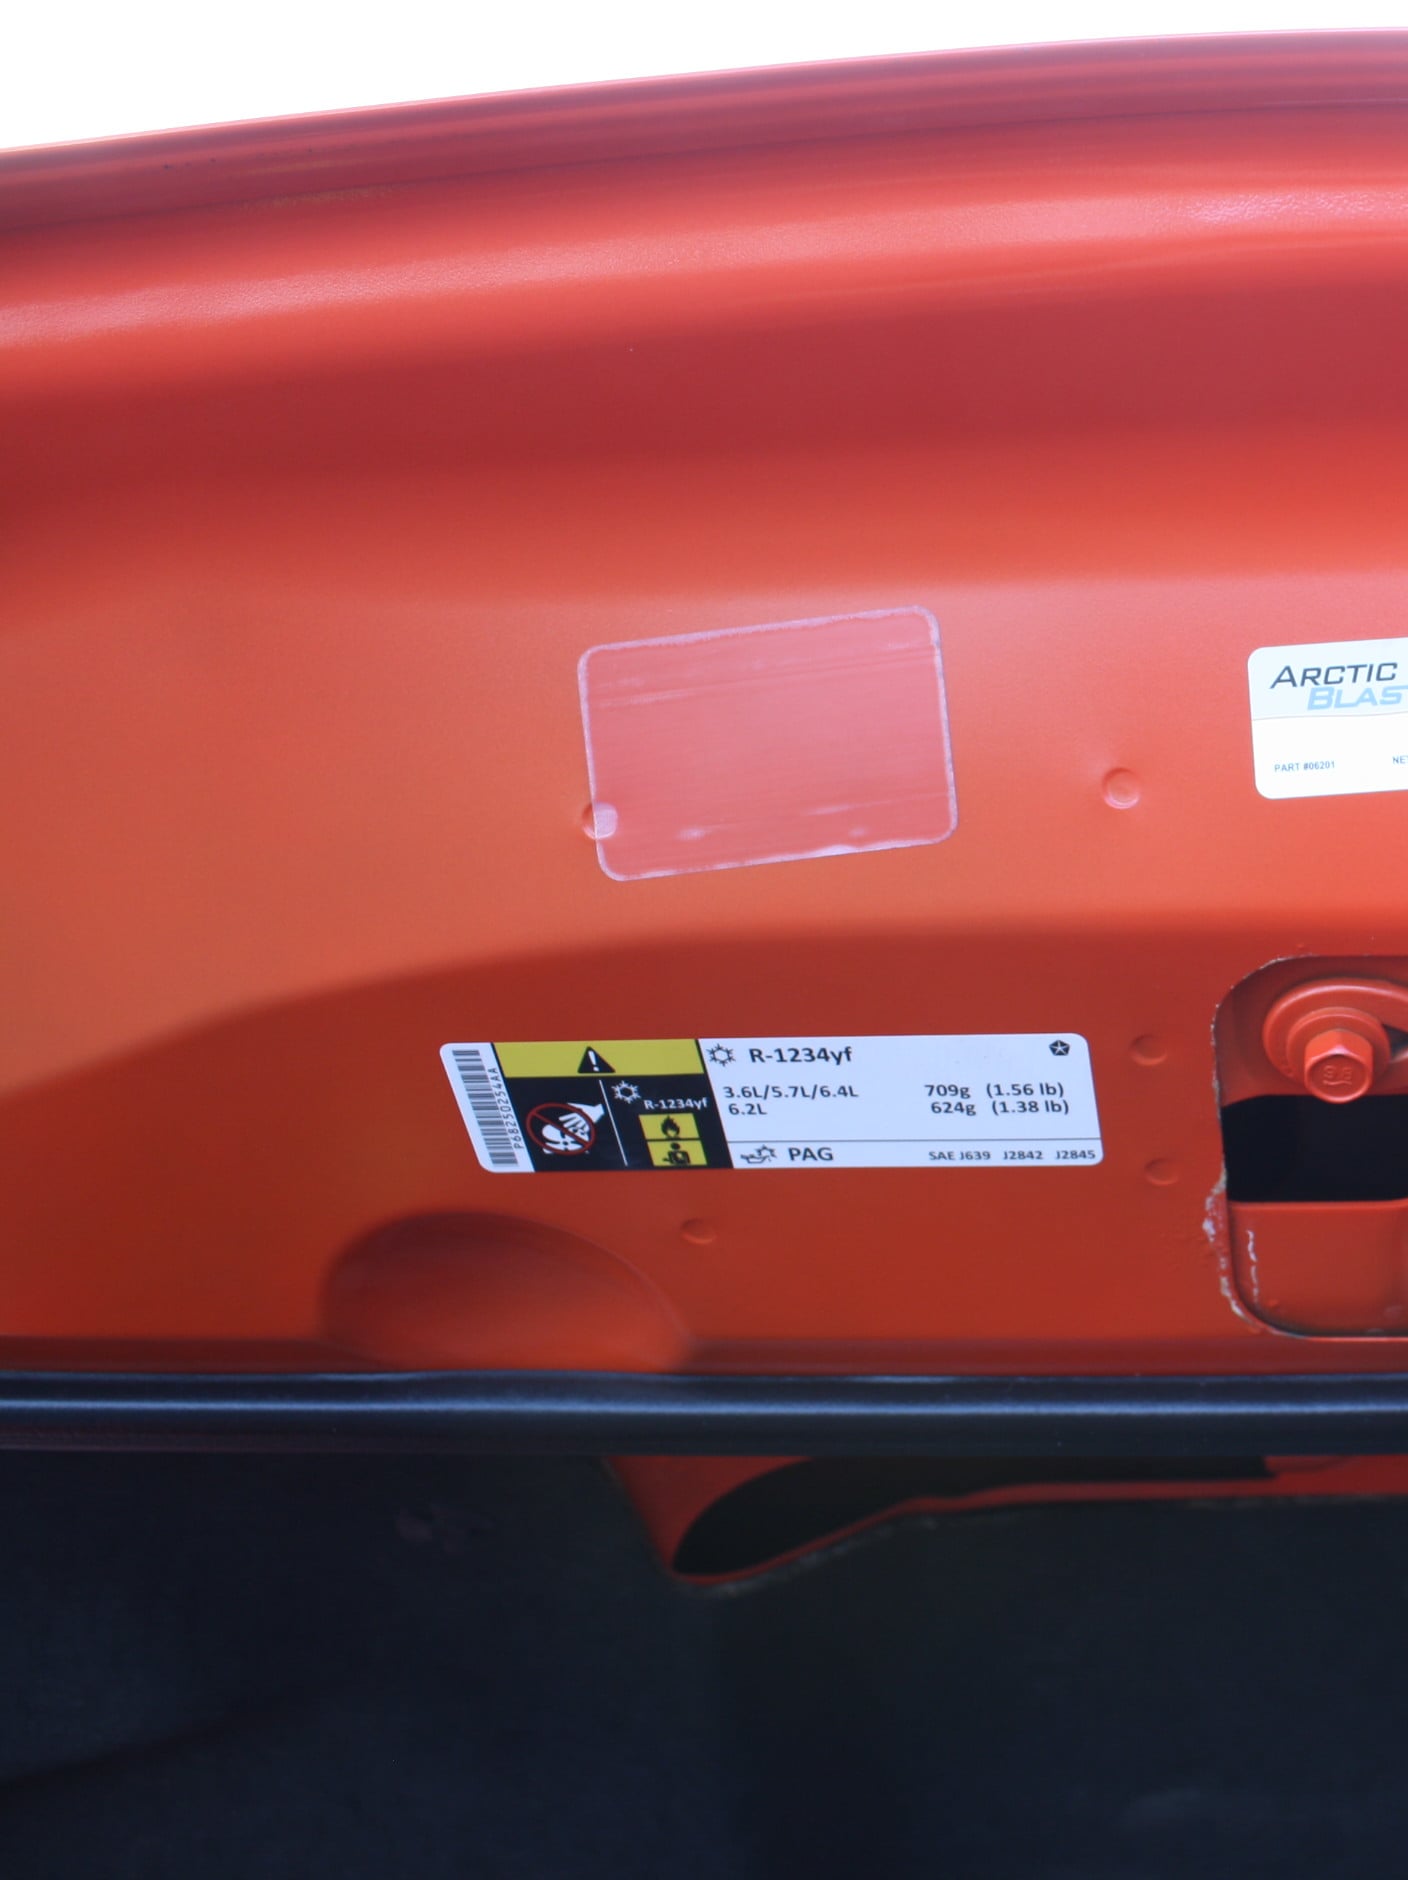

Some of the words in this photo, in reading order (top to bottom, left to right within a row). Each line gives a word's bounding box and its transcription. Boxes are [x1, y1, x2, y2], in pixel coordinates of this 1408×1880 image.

[1270, 662, 1398, 689] ARCTIC
[1274, 762, 1300, 773] PART
[1303, 760, 1336, 771] #06201
[748, 1047, 853, 1064] R-1234yf
[723, 1085, 860, 1100] 3.6L/5.7L/6.4L
[924, 1083, 971, 1099] 709g
[985, 1082, 1034, 1098] (1.56
[1039, 1081, 1066, 1097] lb)
[643, 1097, 708, 1111] R-1234yf
[727, 1102, 768, 1116] 6.2L
[930, 1101, 977, 1117] 624g
[991, 1100, 1039, 1116] (1.38
[1045, 1099, 1070, 1116] lb)
[788, 1147, 834, 1162] PAG
[928, 1150, 955, 1161] SAE
[959, 1150, 991, 1161] J639
[1002, 1149, 1044, 1161] J2842
[1055, 1149, 1096, 1161] J2845
